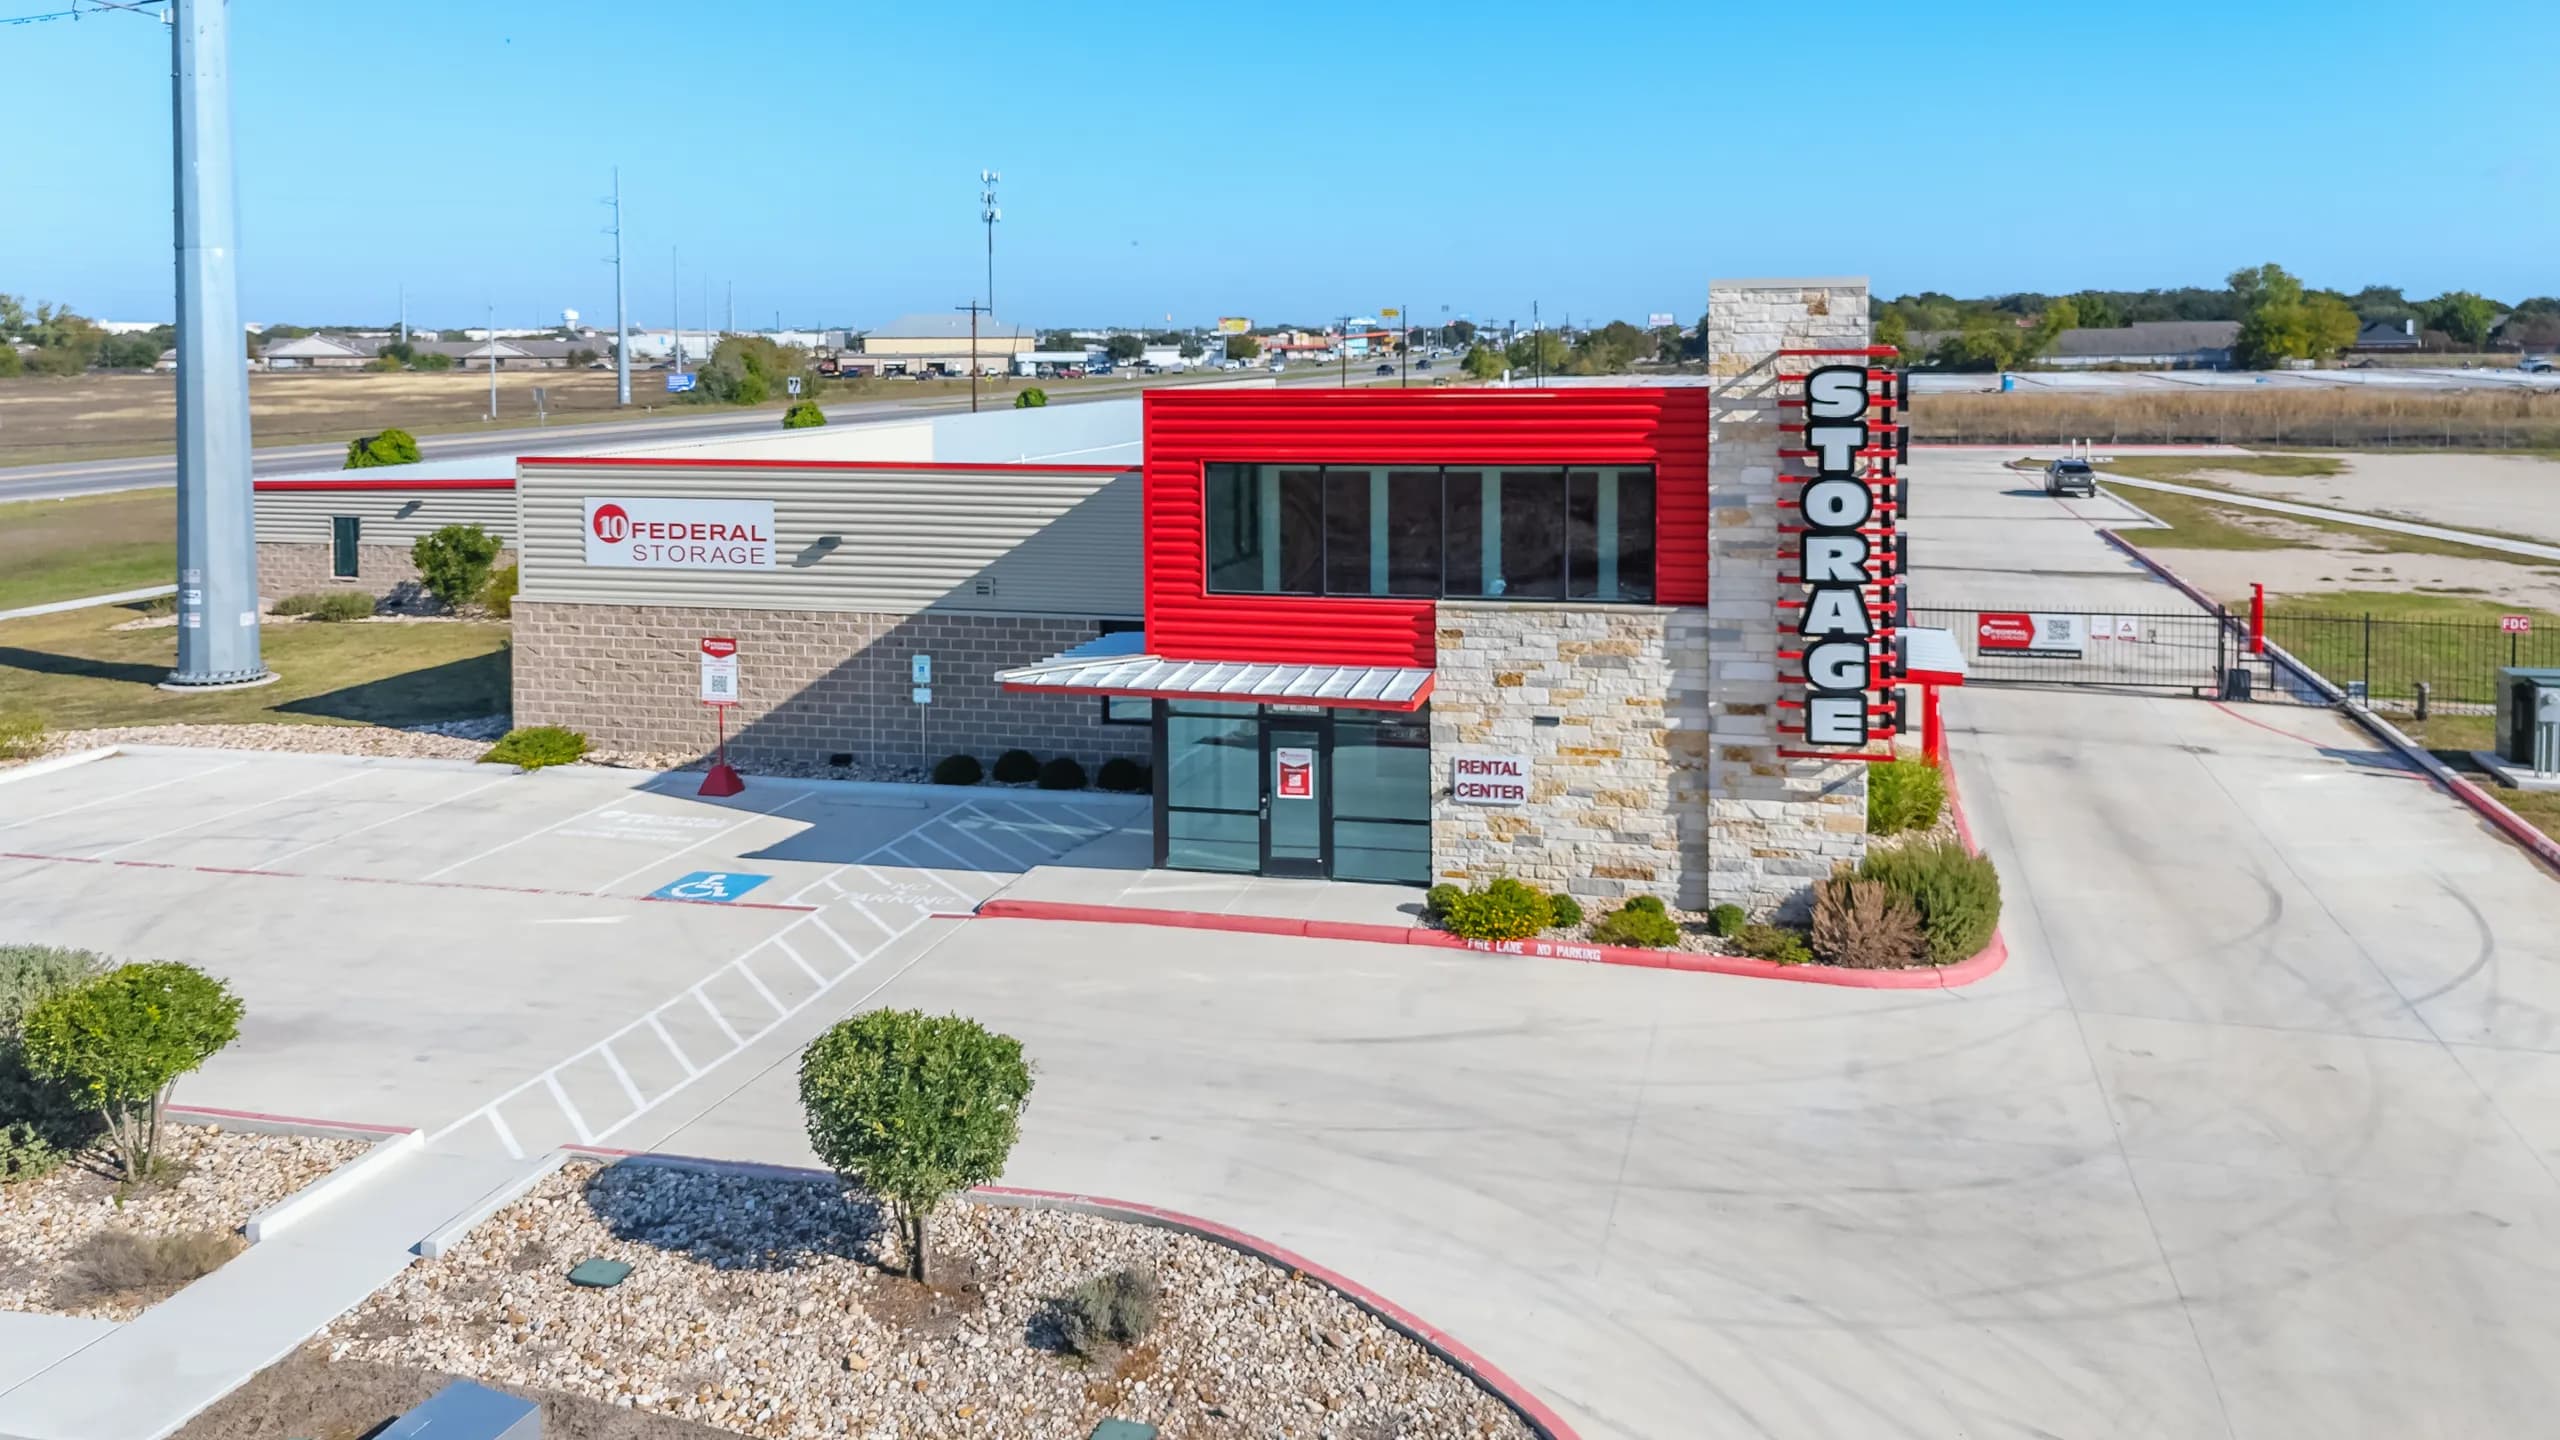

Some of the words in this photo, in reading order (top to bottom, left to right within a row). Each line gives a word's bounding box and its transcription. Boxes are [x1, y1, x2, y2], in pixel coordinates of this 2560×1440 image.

[598, 515, 629, 540] 10
[632, 522, 767, 542] FEDERAL
[632, 544, 766, 565] STORAGE
[1800, 365, 1874, 746] STORAGE
[2503, 618, 2528, 630] FDC
[1458, 760, 1522, 776] RENTAL
[1457, 782, 1524, 799] CENTER
[889, 882, 932, 892] NO
[1467, 938, 1490, 951] FIRE
[1495, 941, 1524, 954] LANE
[1536, 943, 1551, 956] NO
[1556, 945, 1601, 961] PARKING
